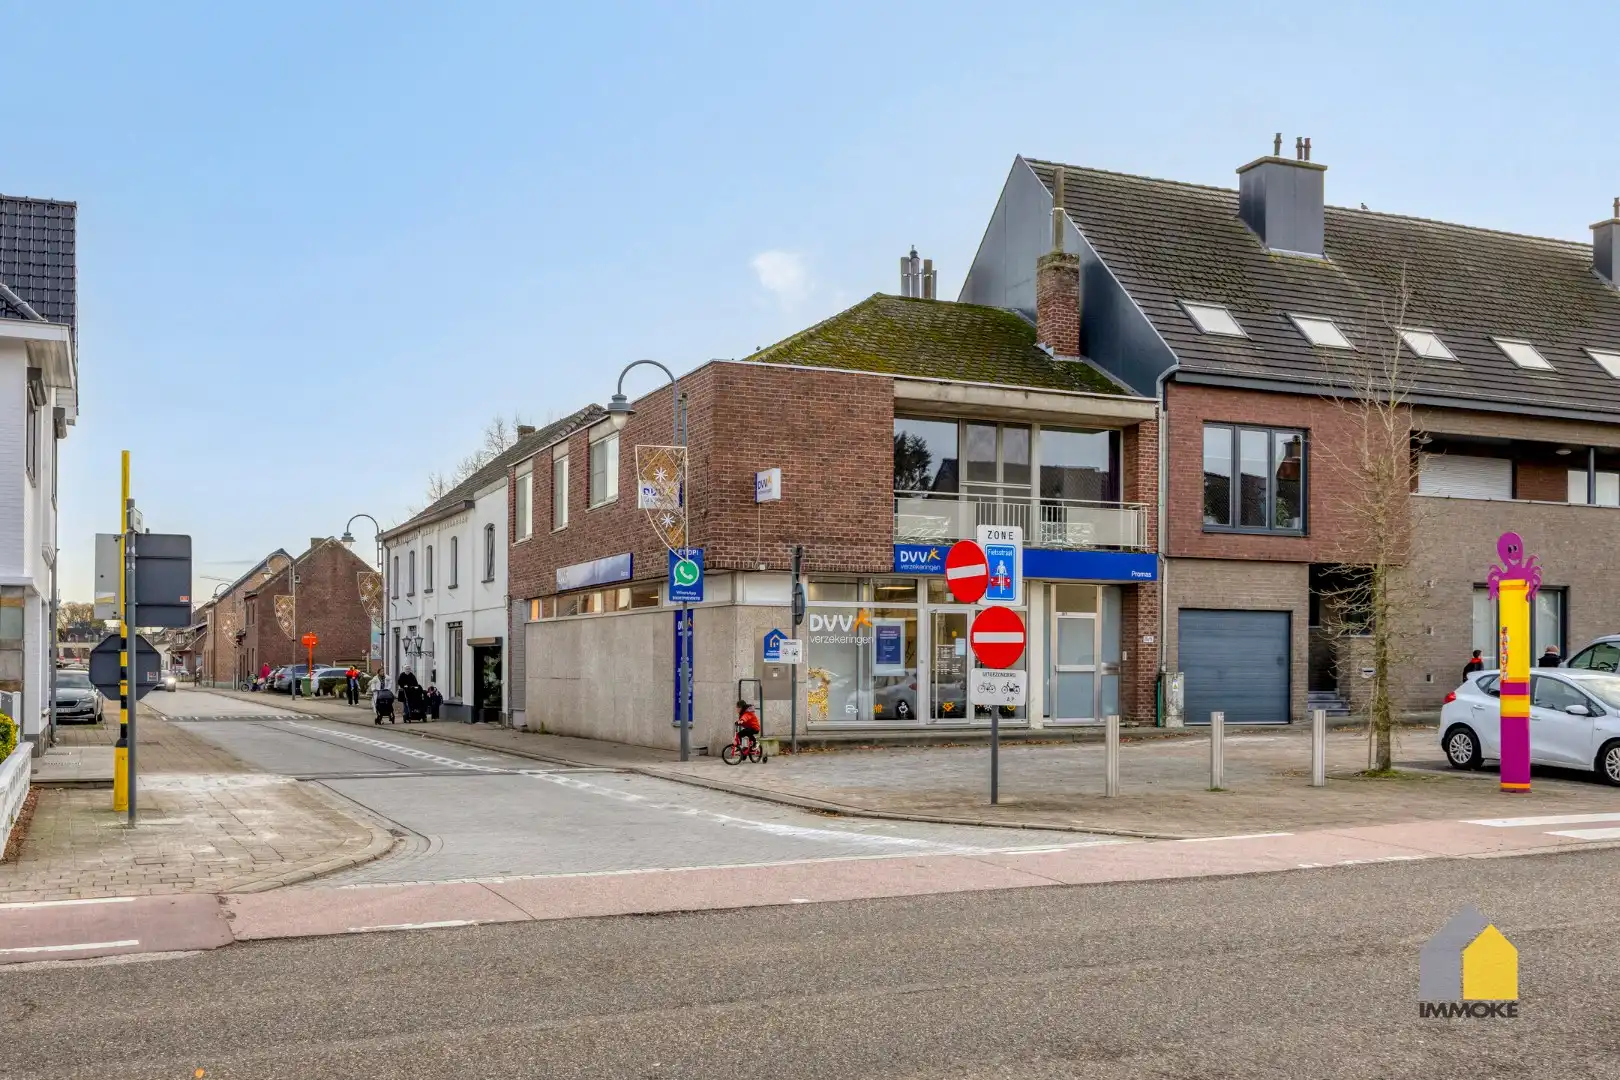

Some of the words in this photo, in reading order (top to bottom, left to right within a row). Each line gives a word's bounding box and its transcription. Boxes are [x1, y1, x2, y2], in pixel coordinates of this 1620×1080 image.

[987, 530, 1014, 540] ZONE
[900, 550, 928, 563] DVV
[900, 564, 941, 572] verzekeringen
[1131, 570, 1152, 578] Promas
[809, 614, 853, 632] DVV
[809, 634, 873, 646] verzekeringen
